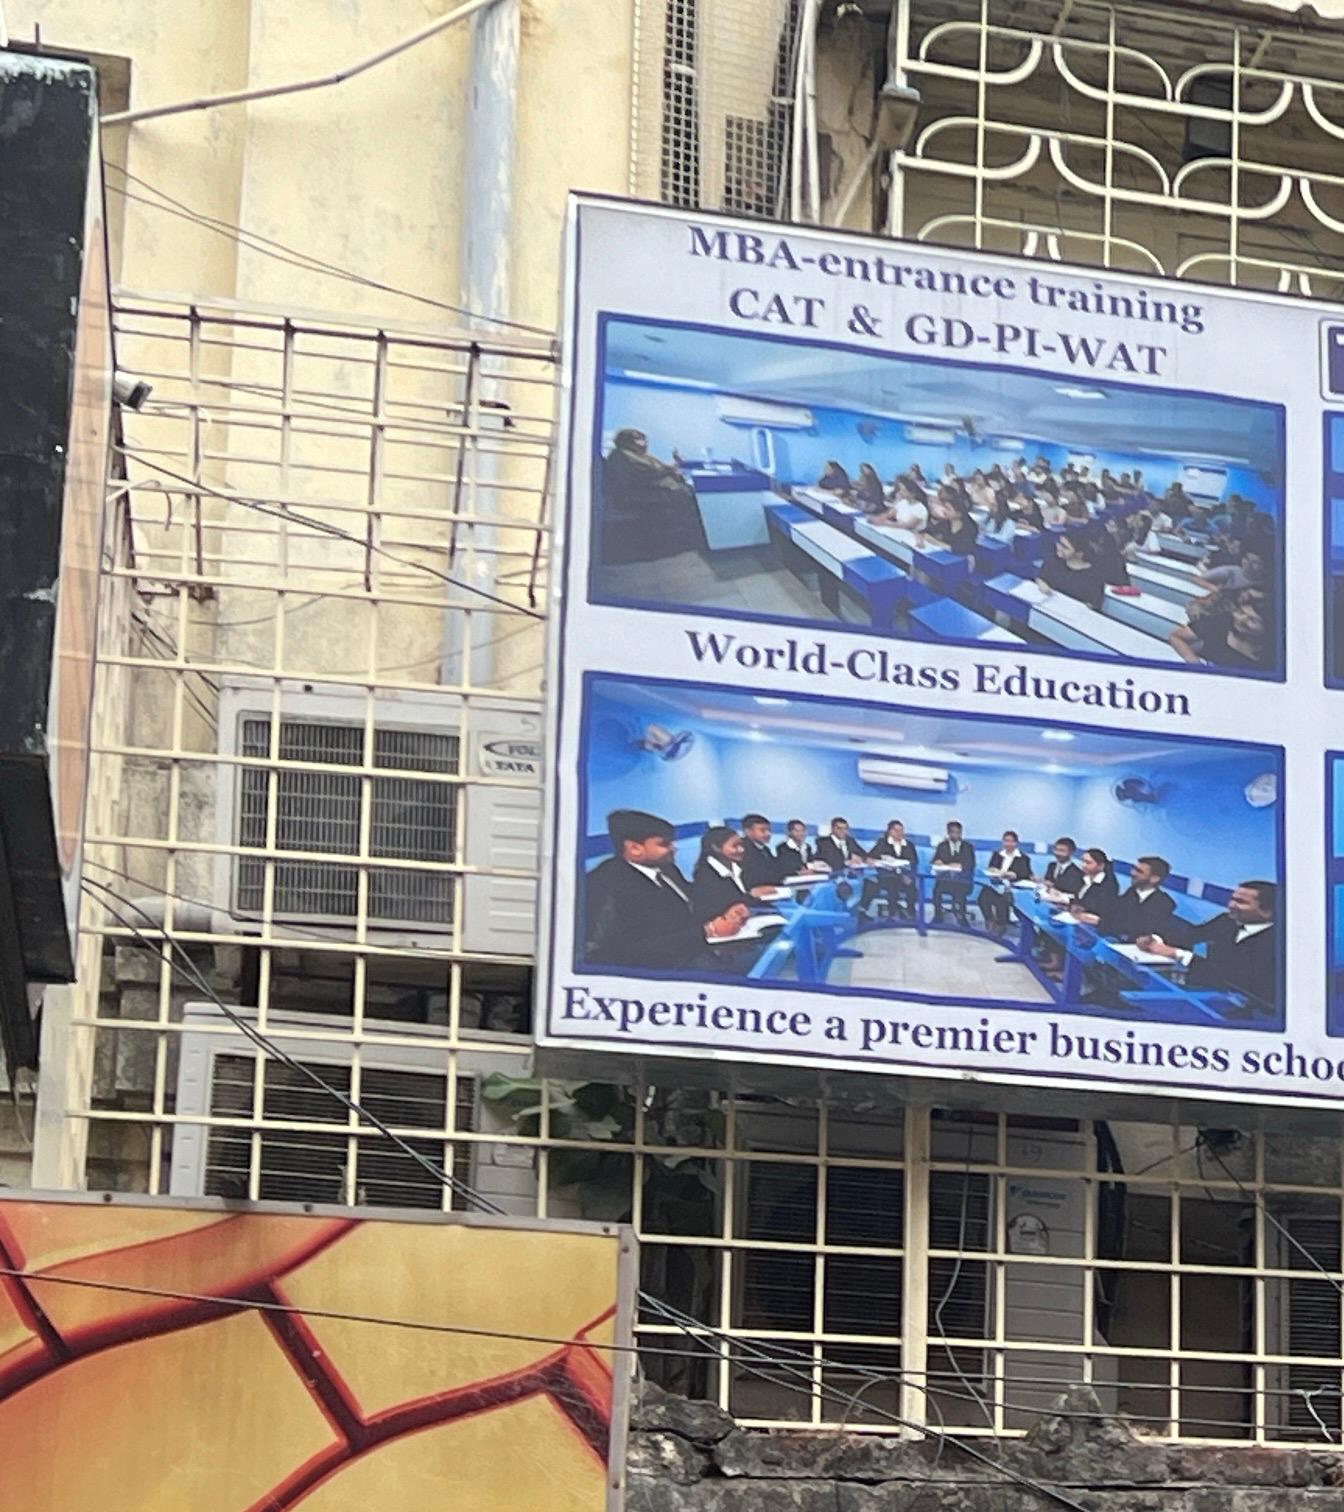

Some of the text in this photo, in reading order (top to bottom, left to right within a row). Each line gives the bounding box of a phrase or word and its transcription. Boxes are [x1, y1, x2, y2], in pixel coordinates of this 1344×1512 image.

[687, 225, 1204, 334] MBA-entrance training
[729, 286, 1167, 376] CAT & GD-PI-WAT
[685, 630, 1191, 716] World-Class Education
[560, 985, 812, 1043] Experience
[826, 1015, 849, 1043] a
[861, 1008, 1038, 1069] premier
[1050, 1019, 1231, 1074] business
